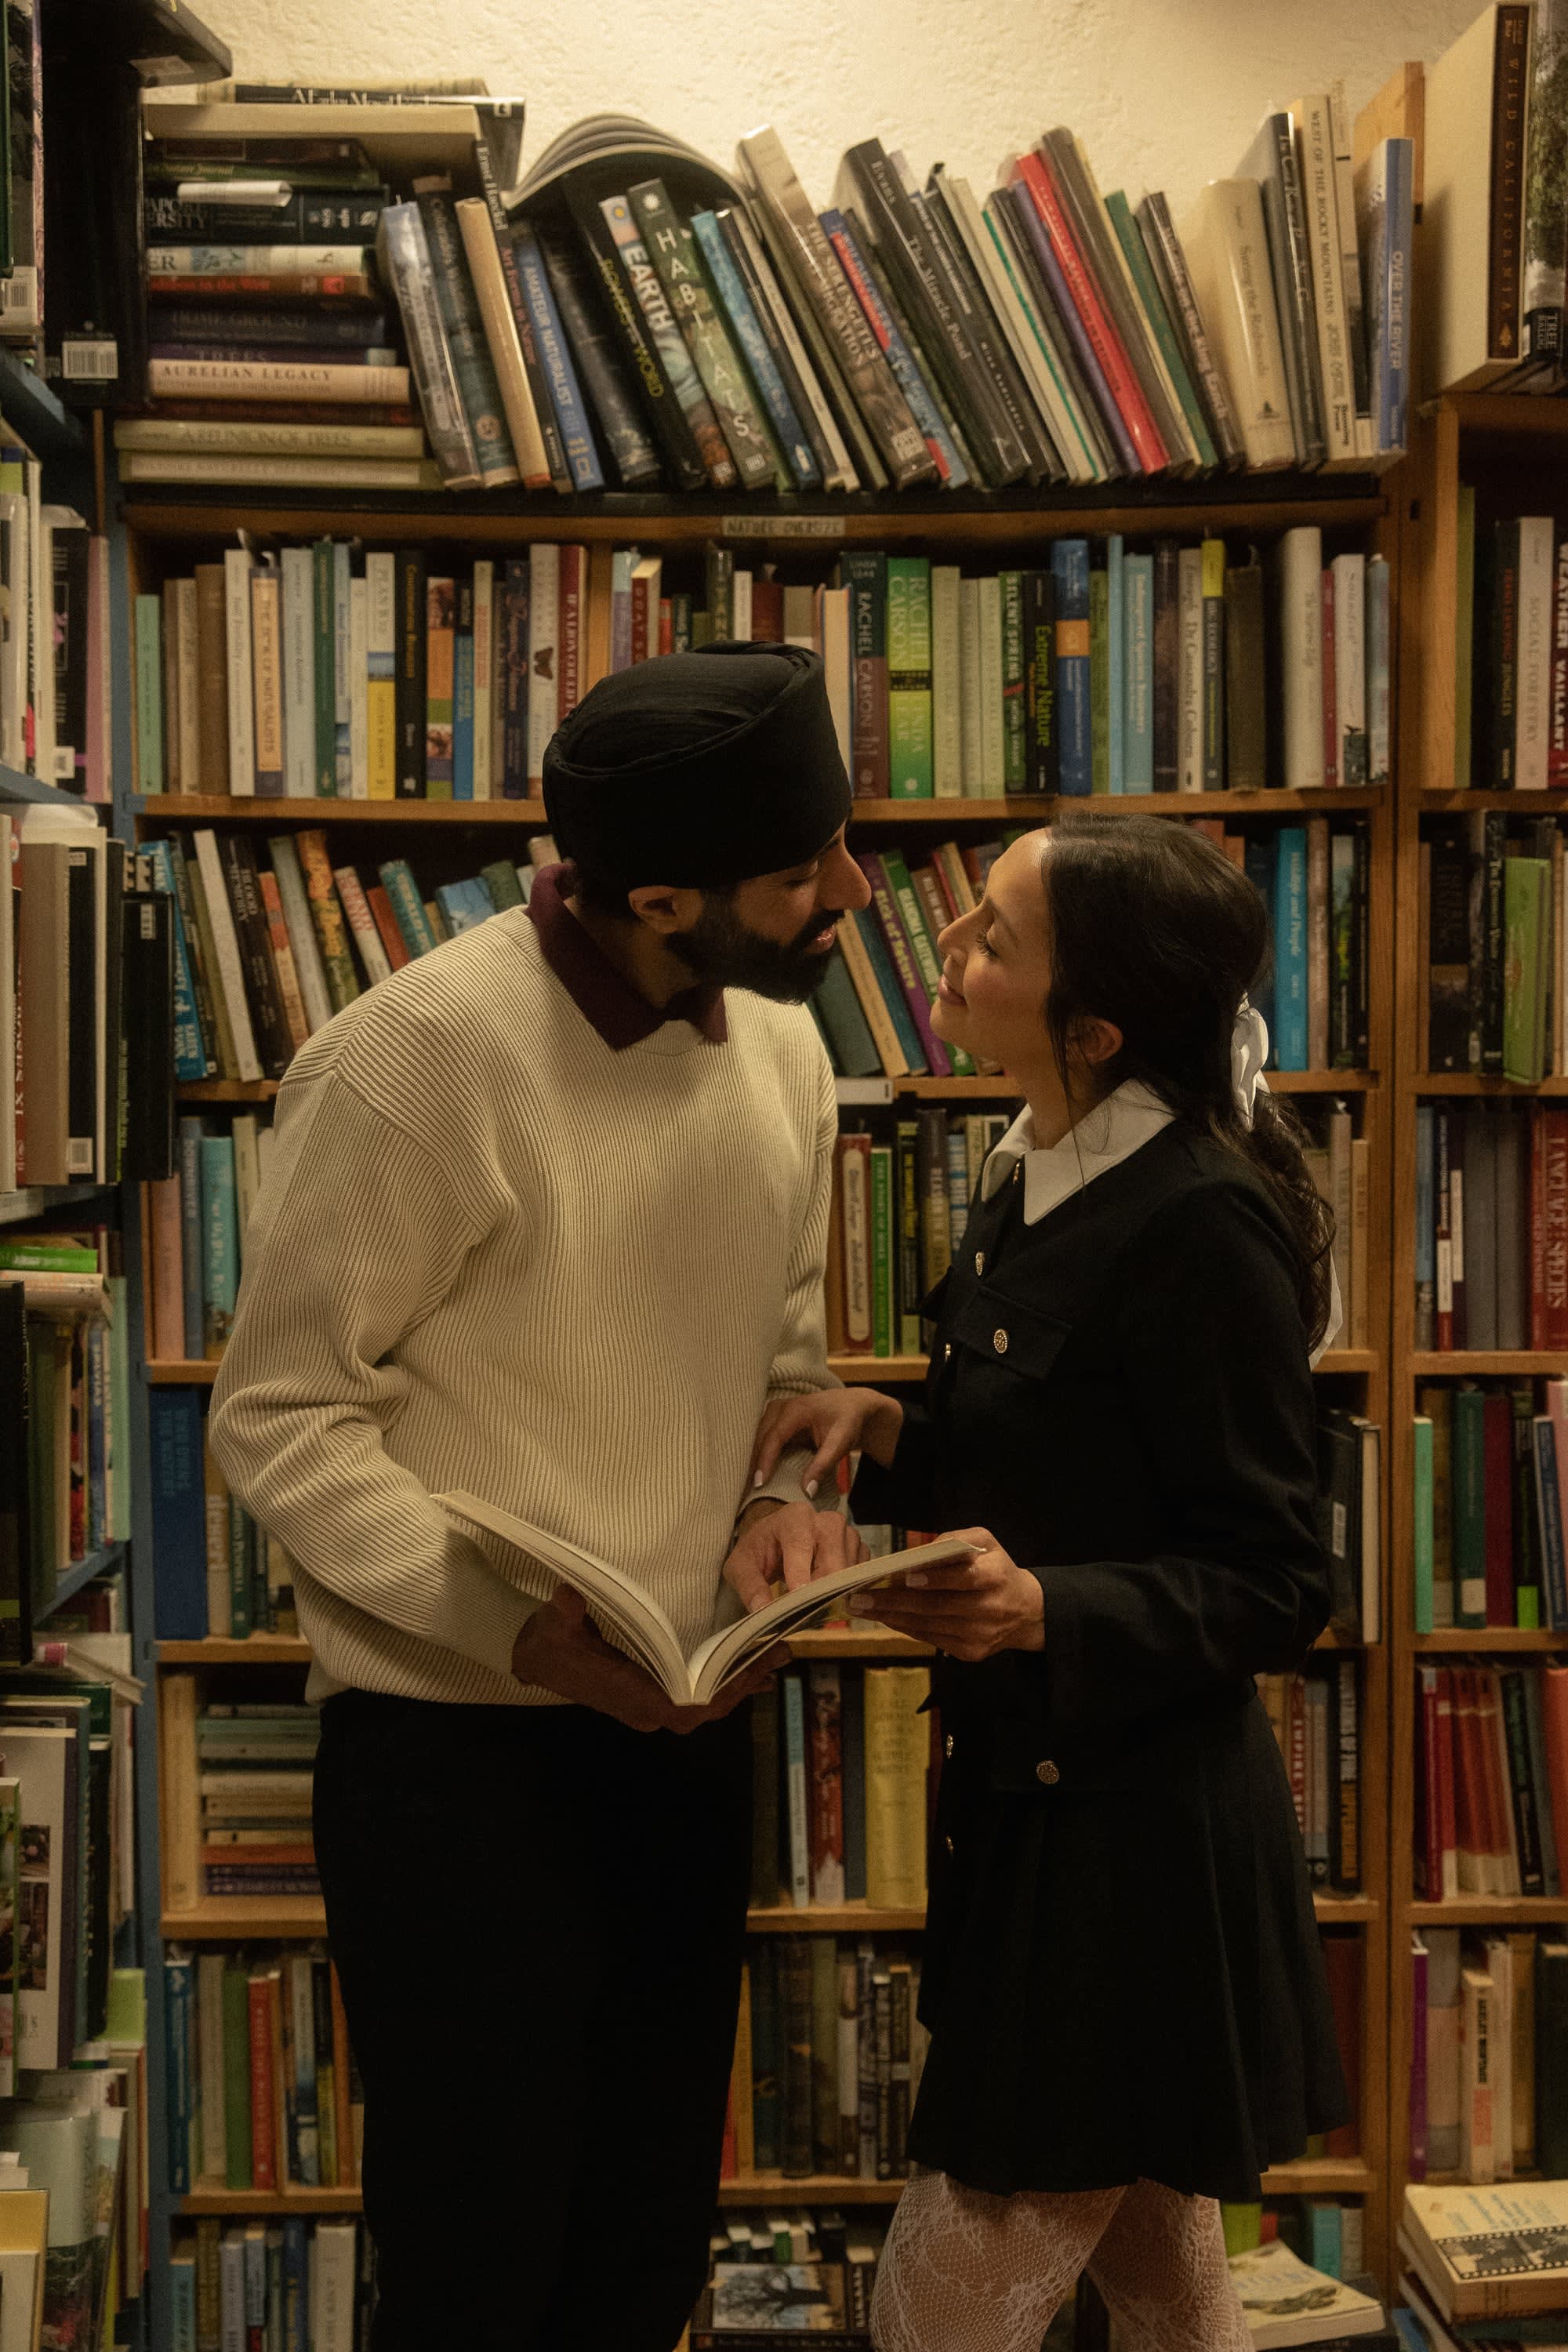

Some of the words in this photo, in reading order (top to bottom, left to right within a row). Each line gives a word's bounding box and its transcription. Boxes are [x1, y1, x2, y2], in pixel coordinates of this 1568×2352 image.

[1504, 56, 1519, 121] WILD
[1307, 109, 1323, 142] WEST
[1311, 145, 1325, 162] OF
[1311, 166, 1327, 191] THE
[804, 219, 827, 252] THE
[1312, 195, 1330, 238] ROCKY
[1499, 140, 1519, 312] CALIFORNIA
[905, 234, 929, 265] The
[1391, 250, 1404, 291] OVER
[615, 239, 682, 334] EARTH
[916, 265, 956, 323] Miracle
[1316, 241, 1338, 314] MOUNTAINS
[646, 224, 764, 438] HABITATS
[815, 279, 868, 368] MIGRATION
[1390, 294, 1403, 322] THE
[1544, 312, 1559, 350] TREE
[521, 264, 551, 328] AMATEUR
[538, 326, 574, 408] NATURALIST
[943, 320, 974, 362] Pond
[1389, 325, 1402, 369] RIVER
[163, 365, 253, 378] AURELIAN
[262, 367, 332, 381] LEGACY
[855, 590, 873, 655] RACHEL
[888, 575, 907, 666] CARSON
[908, 576, 929, 662] RACHEL
[1005, 575, 1022, 626] SILENT
[1132, 572, 1147, 639] Endangered
[1185, 621, 1199, 638] Dr
[1205, 622, 1218, 675] ECOLOGY
[1527, 597, 1540, 657] SOCIAL
[1006, 629, 1022, 680] SPRING
[1034, 624, 1053, 686] Extreme
[1132, 641, 1147, 681] Species
[1183, 642, 1199, 705] Cassandra
[857, 658, 875, 729] CARSON
[1035, 688, 1055, 748] Nature
[1524, 663, 1540, 742] FORESTRY
[1552, 658, 1566, 751] VAILLANT
[1183, 709, 1198, 758] Coburn
[237, 867, 261, 917] BLOOD
[873, 887, 895, 920] Sick
[1290, 896, 1301, 918] and
[884, 919, 902, 940] of
[1287, 920, 1302, 957] People
[889, 938, 920, 990] Nature
[1546, 1136, 1567, 1227] LANGUAGE
[1545, 1240, 1566, 1308] SPECIES
